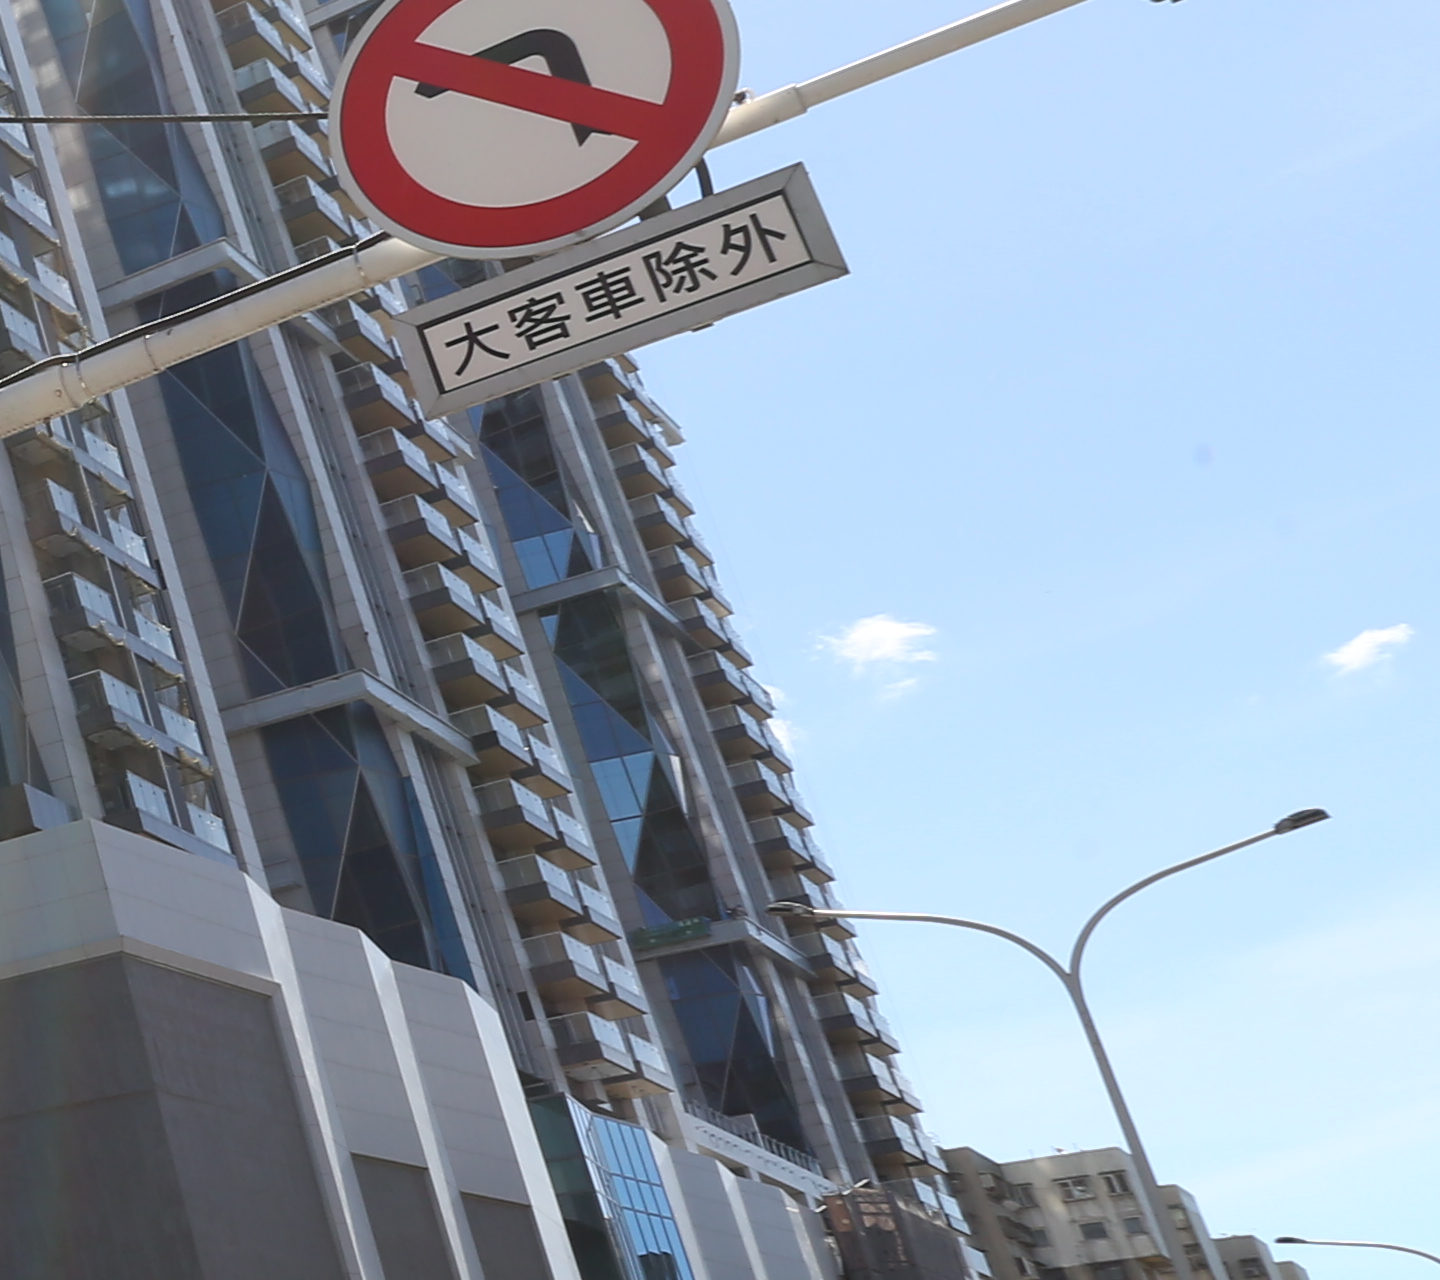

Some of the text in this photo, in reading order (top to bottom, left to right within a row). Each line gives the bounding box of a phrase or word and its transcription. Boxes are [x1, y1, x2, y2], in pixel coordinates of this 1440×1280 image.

[444, 213, 788, 376] 大客車除外
